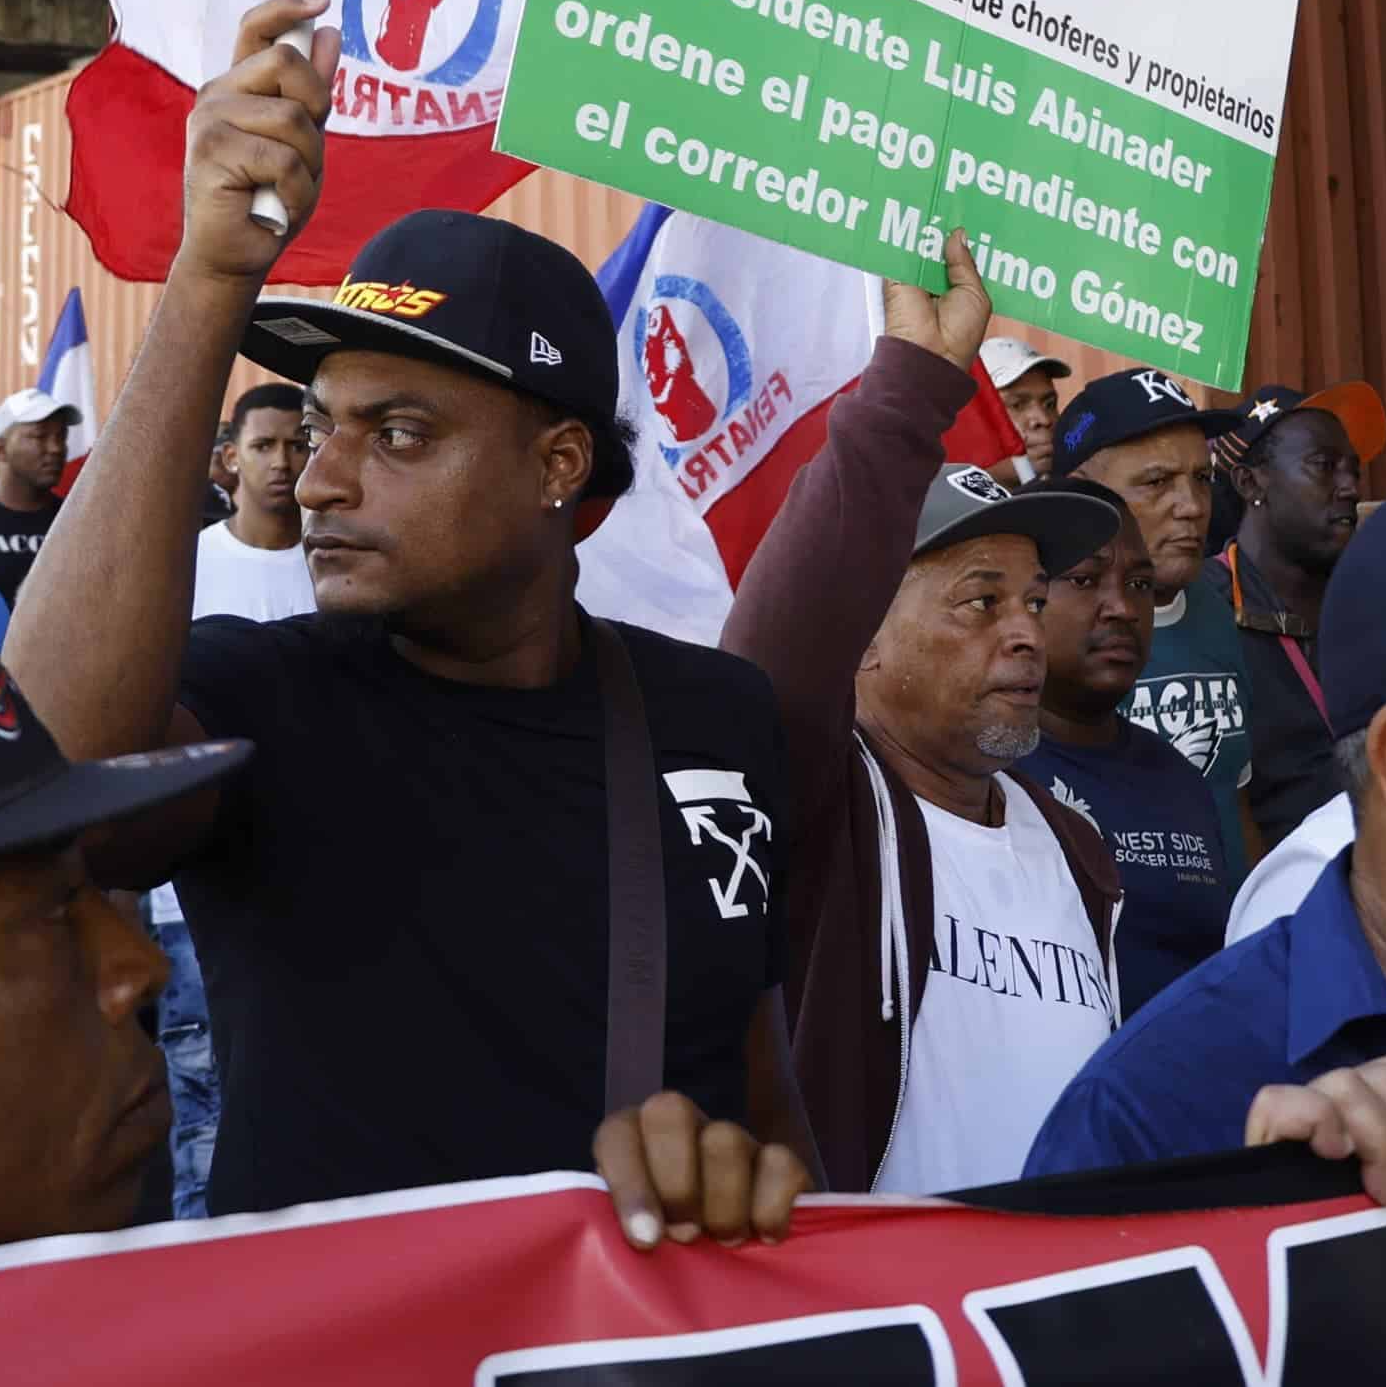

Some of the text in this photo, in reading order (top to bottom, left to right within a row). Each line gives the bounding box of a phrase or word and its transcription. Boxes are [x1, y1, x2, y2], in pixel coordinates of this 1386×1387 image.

[925, 39, 1016, 115] Luis
[1029, 87, 1213, 194] Abinader
[1013, 1, 1119, 68] choferes
[1127, 52, 1141, 83] y
[1147, 59, 1275, 138] propietarios
[555, 0, 1239, 287] ordene el pago pendiente con
[575, 101, 1203, 355] el corredor Máimo Gómez
[1170, 832, 1208, 854] SIDE
[1170, 854, 1213, 871] LEAGUE
